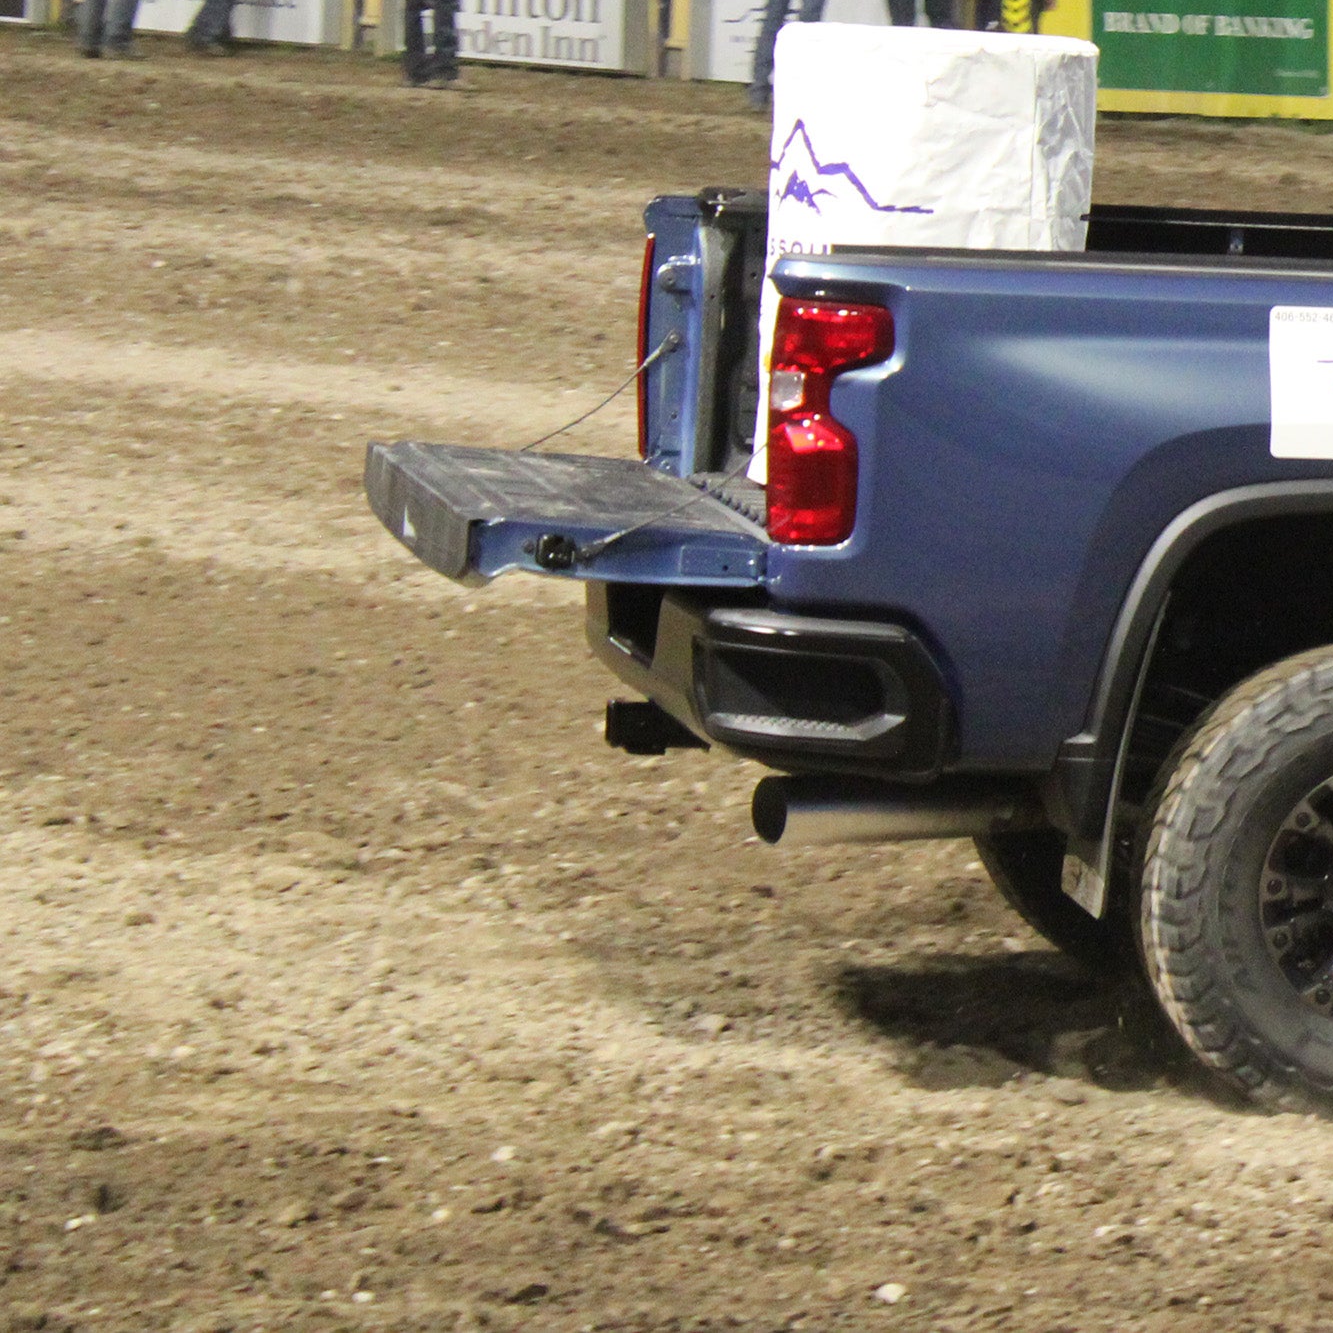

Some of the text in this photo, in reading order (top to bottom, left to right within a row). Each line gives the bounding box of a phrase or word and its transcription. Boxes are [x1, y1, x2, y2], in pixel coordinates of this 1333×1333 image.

[456, 20, 602, 64] rden Inn
[1102, 11, 1316, 40] BRAND OF BANKING
